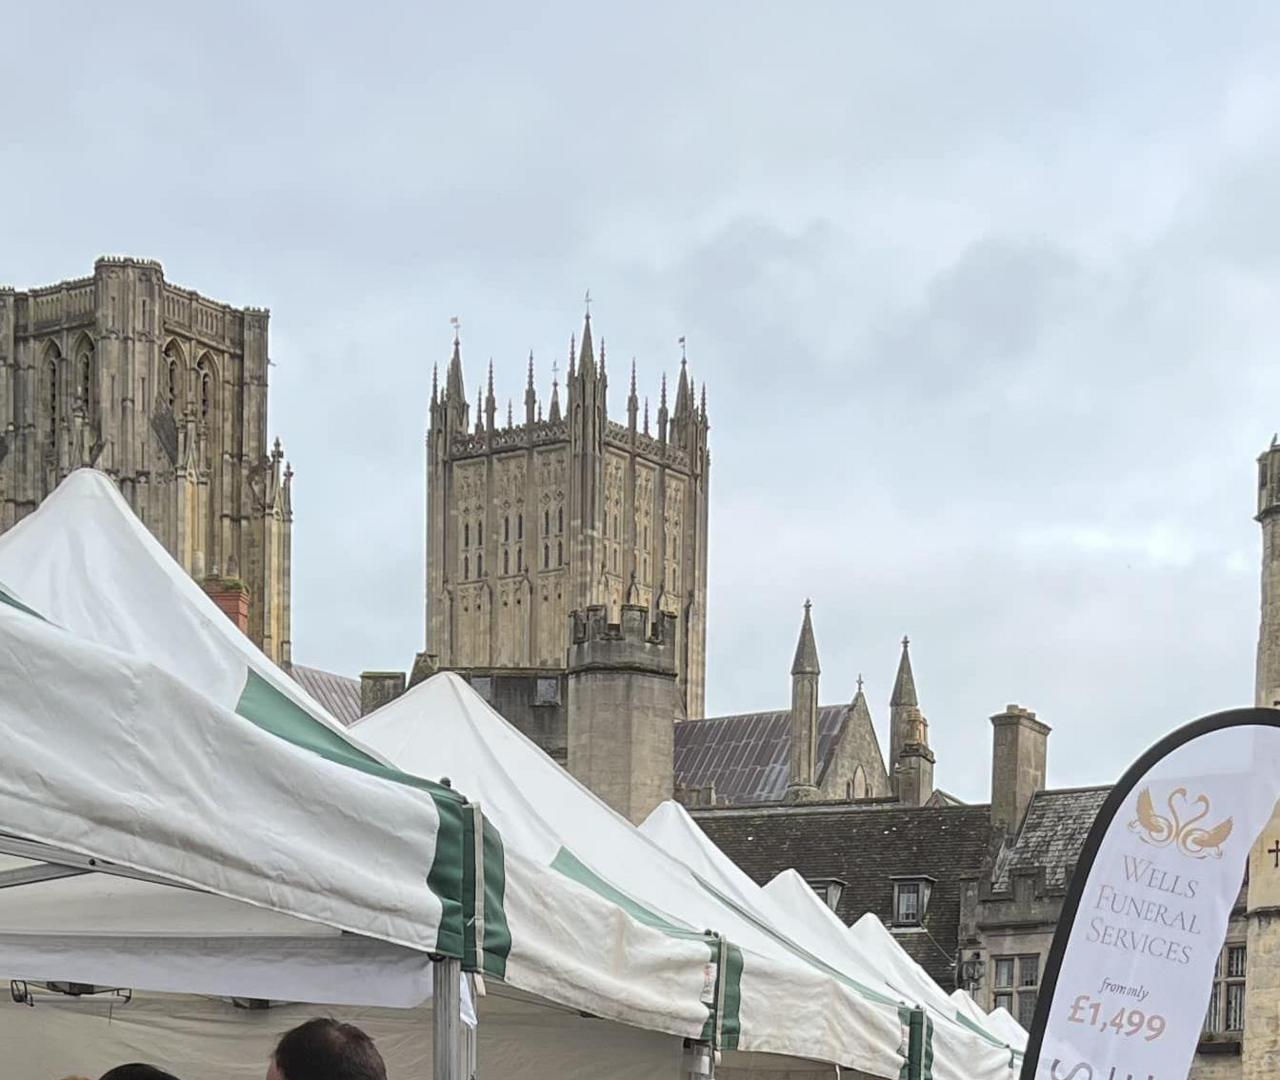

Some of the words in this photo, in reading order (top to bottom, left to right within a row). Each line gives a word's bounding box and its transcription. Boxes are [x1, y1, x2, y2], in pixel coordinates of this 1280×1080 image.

[1098, 976, 1127, 997] from
[1126, 983, 1150, 1002] only
[1068, 994, 1167, 1042] £1,499
